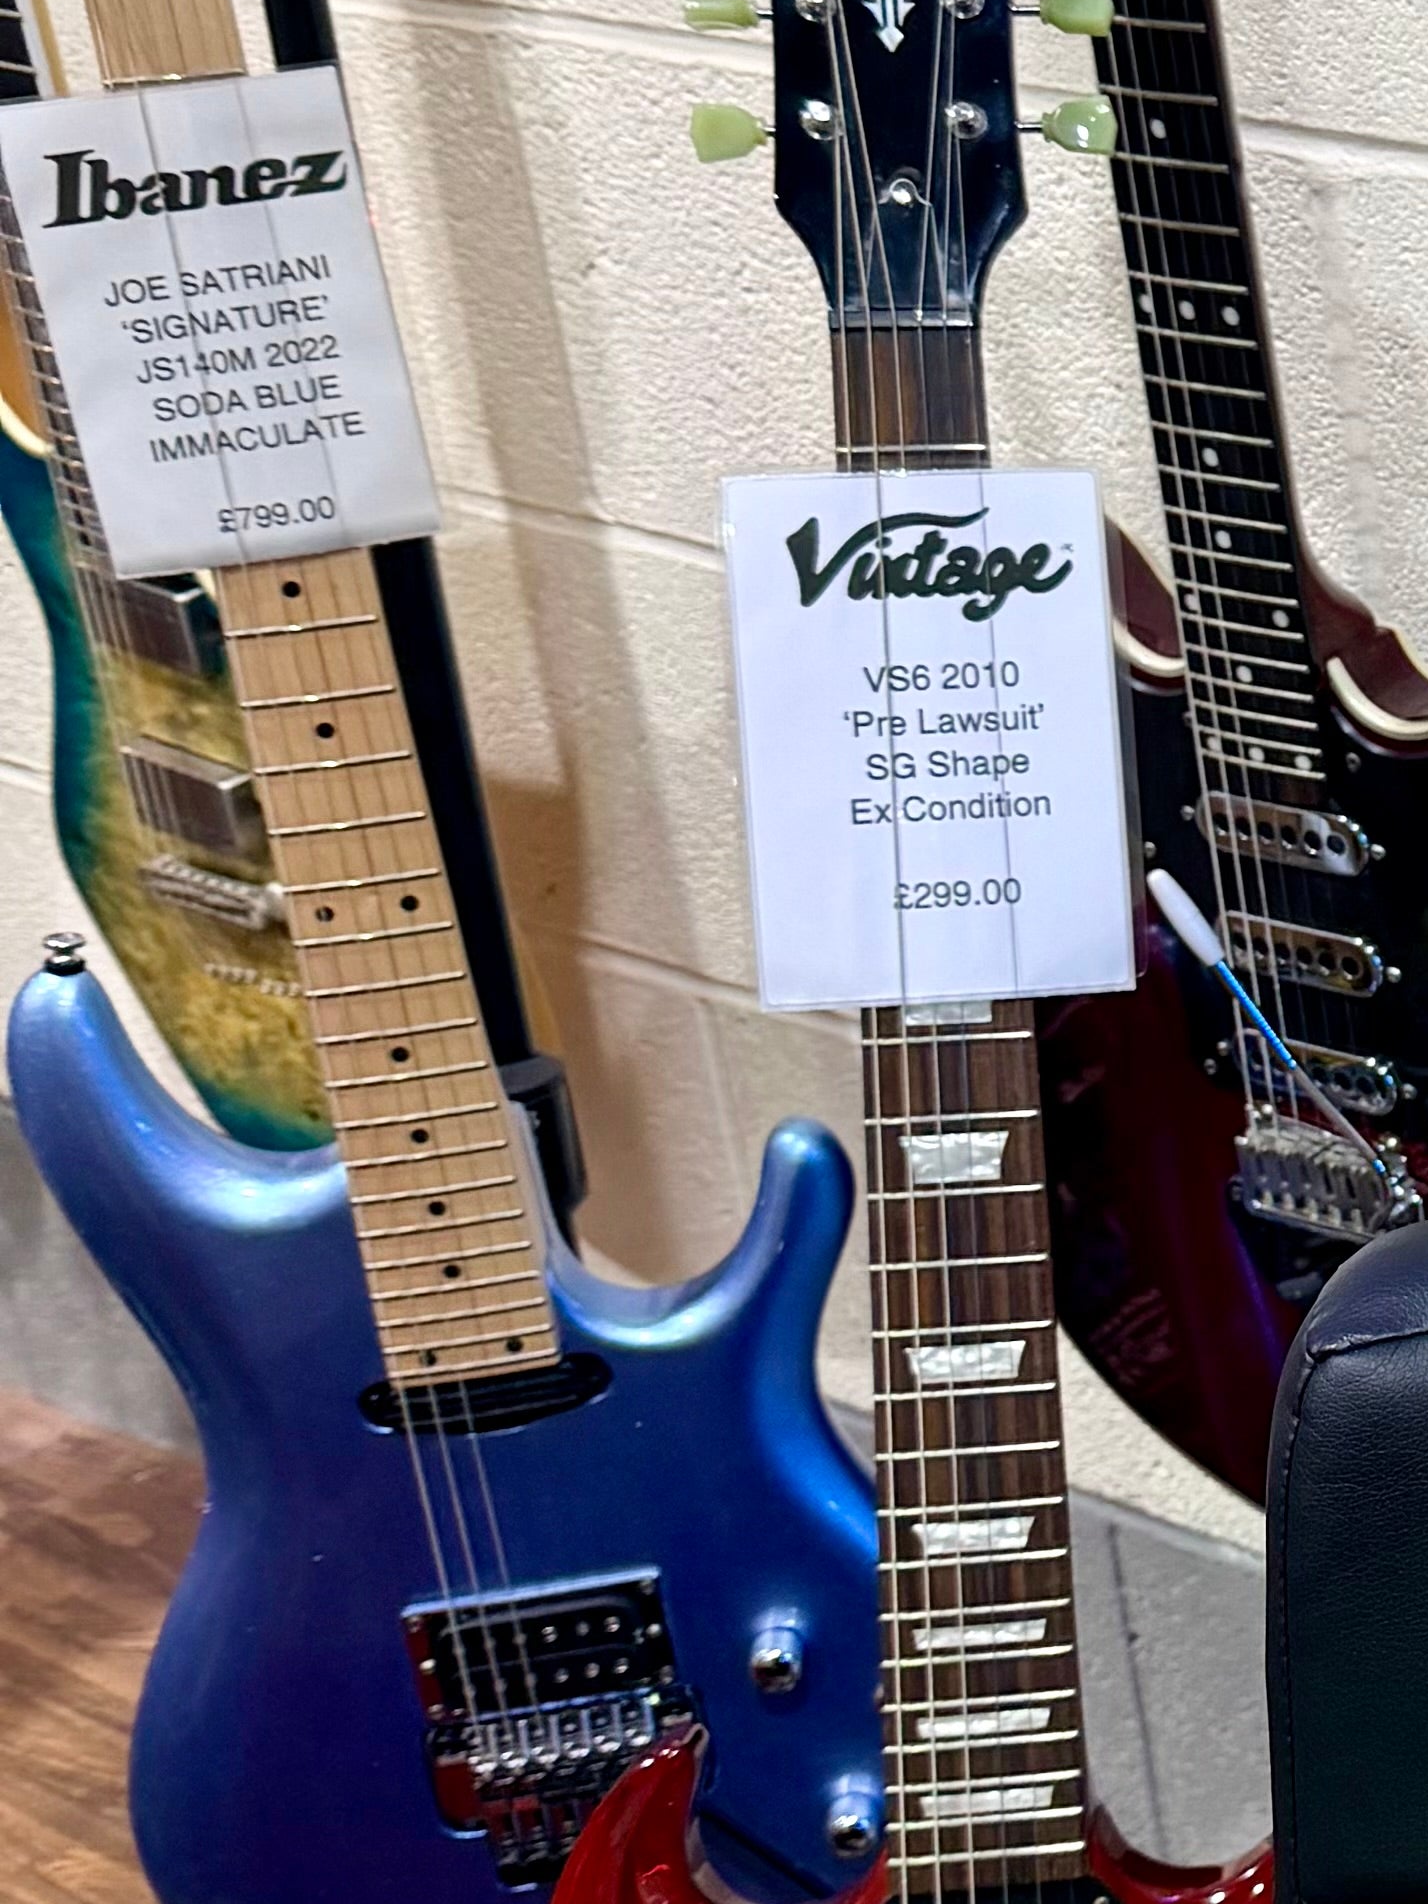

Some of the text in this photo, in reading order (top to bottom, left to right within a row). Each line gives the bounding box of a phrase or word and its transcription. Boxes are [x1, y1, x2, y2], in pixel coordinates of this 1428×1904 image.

[42, 149, 348, 229] Ibanez
[105, 254, 332, 307] JOE SATRIANI
[136, 335, 341, 386] JS140M 2022
[153, 374, 343, 422] SODA BLUE
[150, 411, 367, 463] IMMACULATE
[219, 496, 336, 534] £799.00
[786, 507, 1073, 622] Vintage
[863, 661, 1021, 693] VS6 2010
[843, 711, 907, 737] ‘Pre
[866, 750, 1030, 781] SG Shape
[851, 792, 1051, 825] Ex Condition
[894, 879, 1022, 911] £299.00
